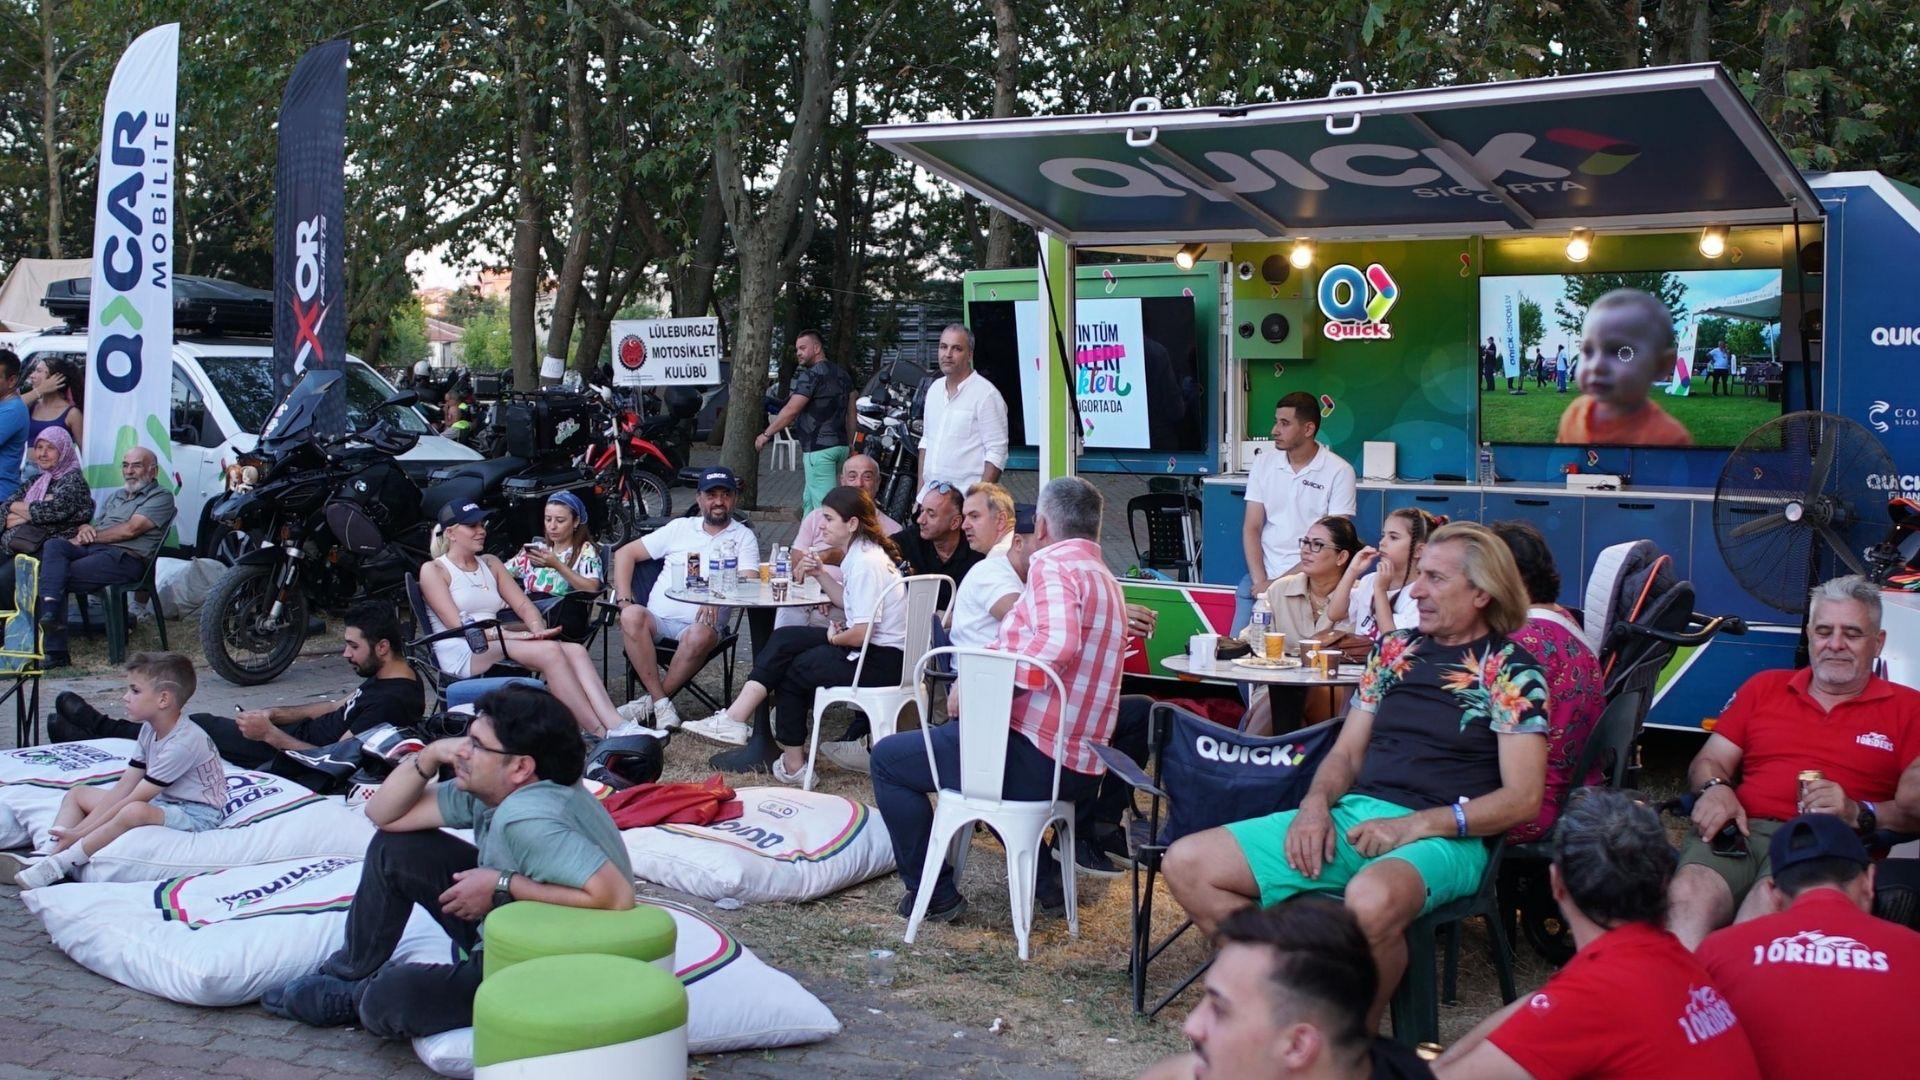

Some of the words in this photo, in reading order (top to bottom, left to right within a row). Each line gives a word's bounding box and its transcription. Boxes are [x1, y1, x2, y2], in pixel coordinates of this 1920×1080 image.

[1039, 132, 1571, 202] QUICK
[320, 213, 328, 306] HELMETS
[649, 324, 715, 338] LÜLEBURGAZ
[1092, 321, 1119, 342] TÜM
[1325, 322, 1389, 339] Quick
[652, 343, 716, 359] MOTOSİKLET
[665, 363, 707, 379] KULÜBÜ
[1196, 735, 1294, 766] QUICK
